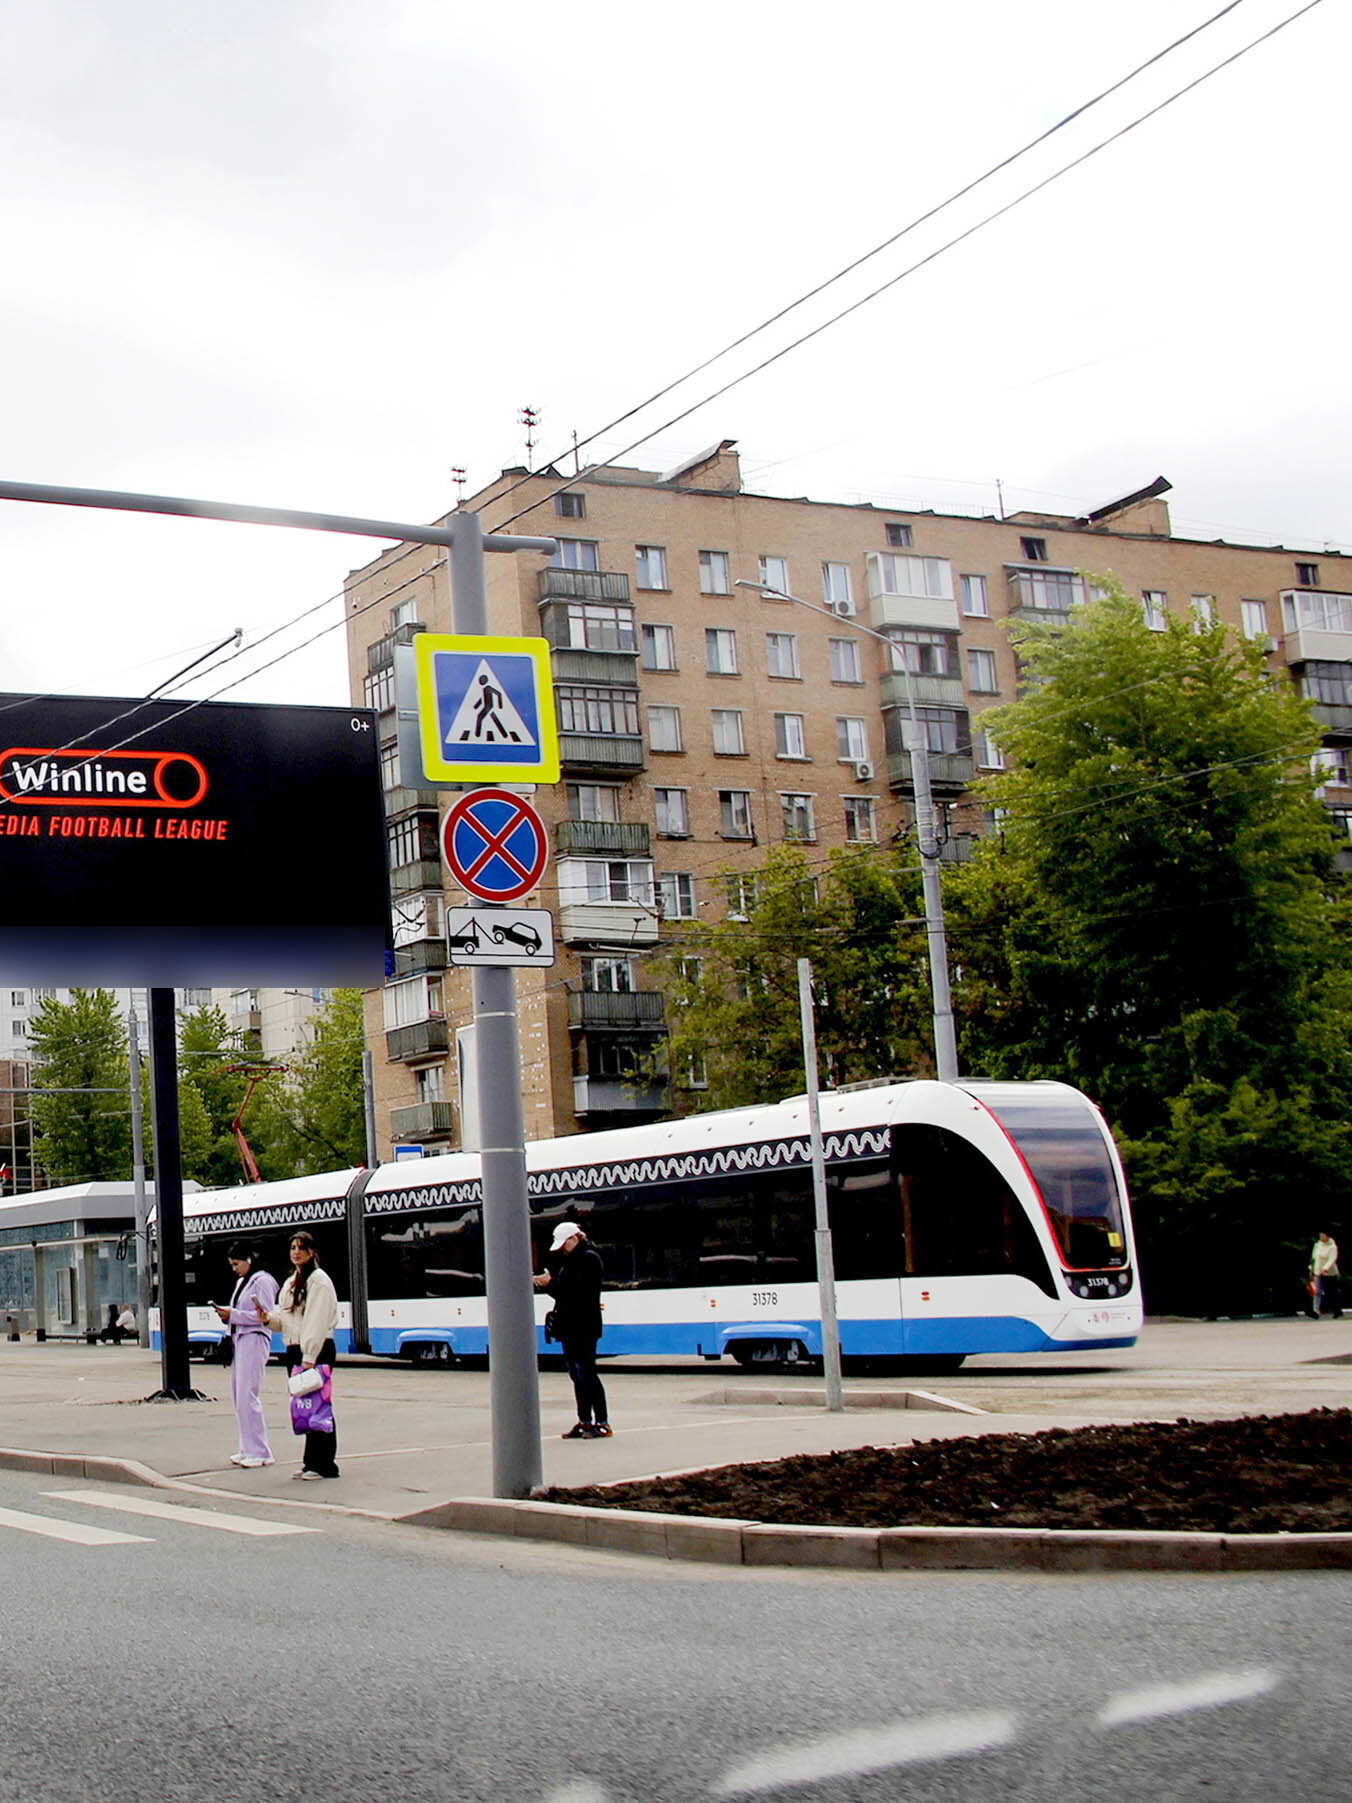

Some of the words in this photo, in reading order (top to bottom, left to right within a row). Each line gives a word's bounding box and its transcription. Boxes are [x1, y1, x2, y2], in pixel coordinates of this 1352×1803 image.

[350, 717, 370, 732] 0+
[12, 761, 147, 794] Winline
[48, 816, 146, 839] FOOTBALL
[154, 818, 229, 841] LEAGUE
[752, 1292, 778, 1306] 31378
